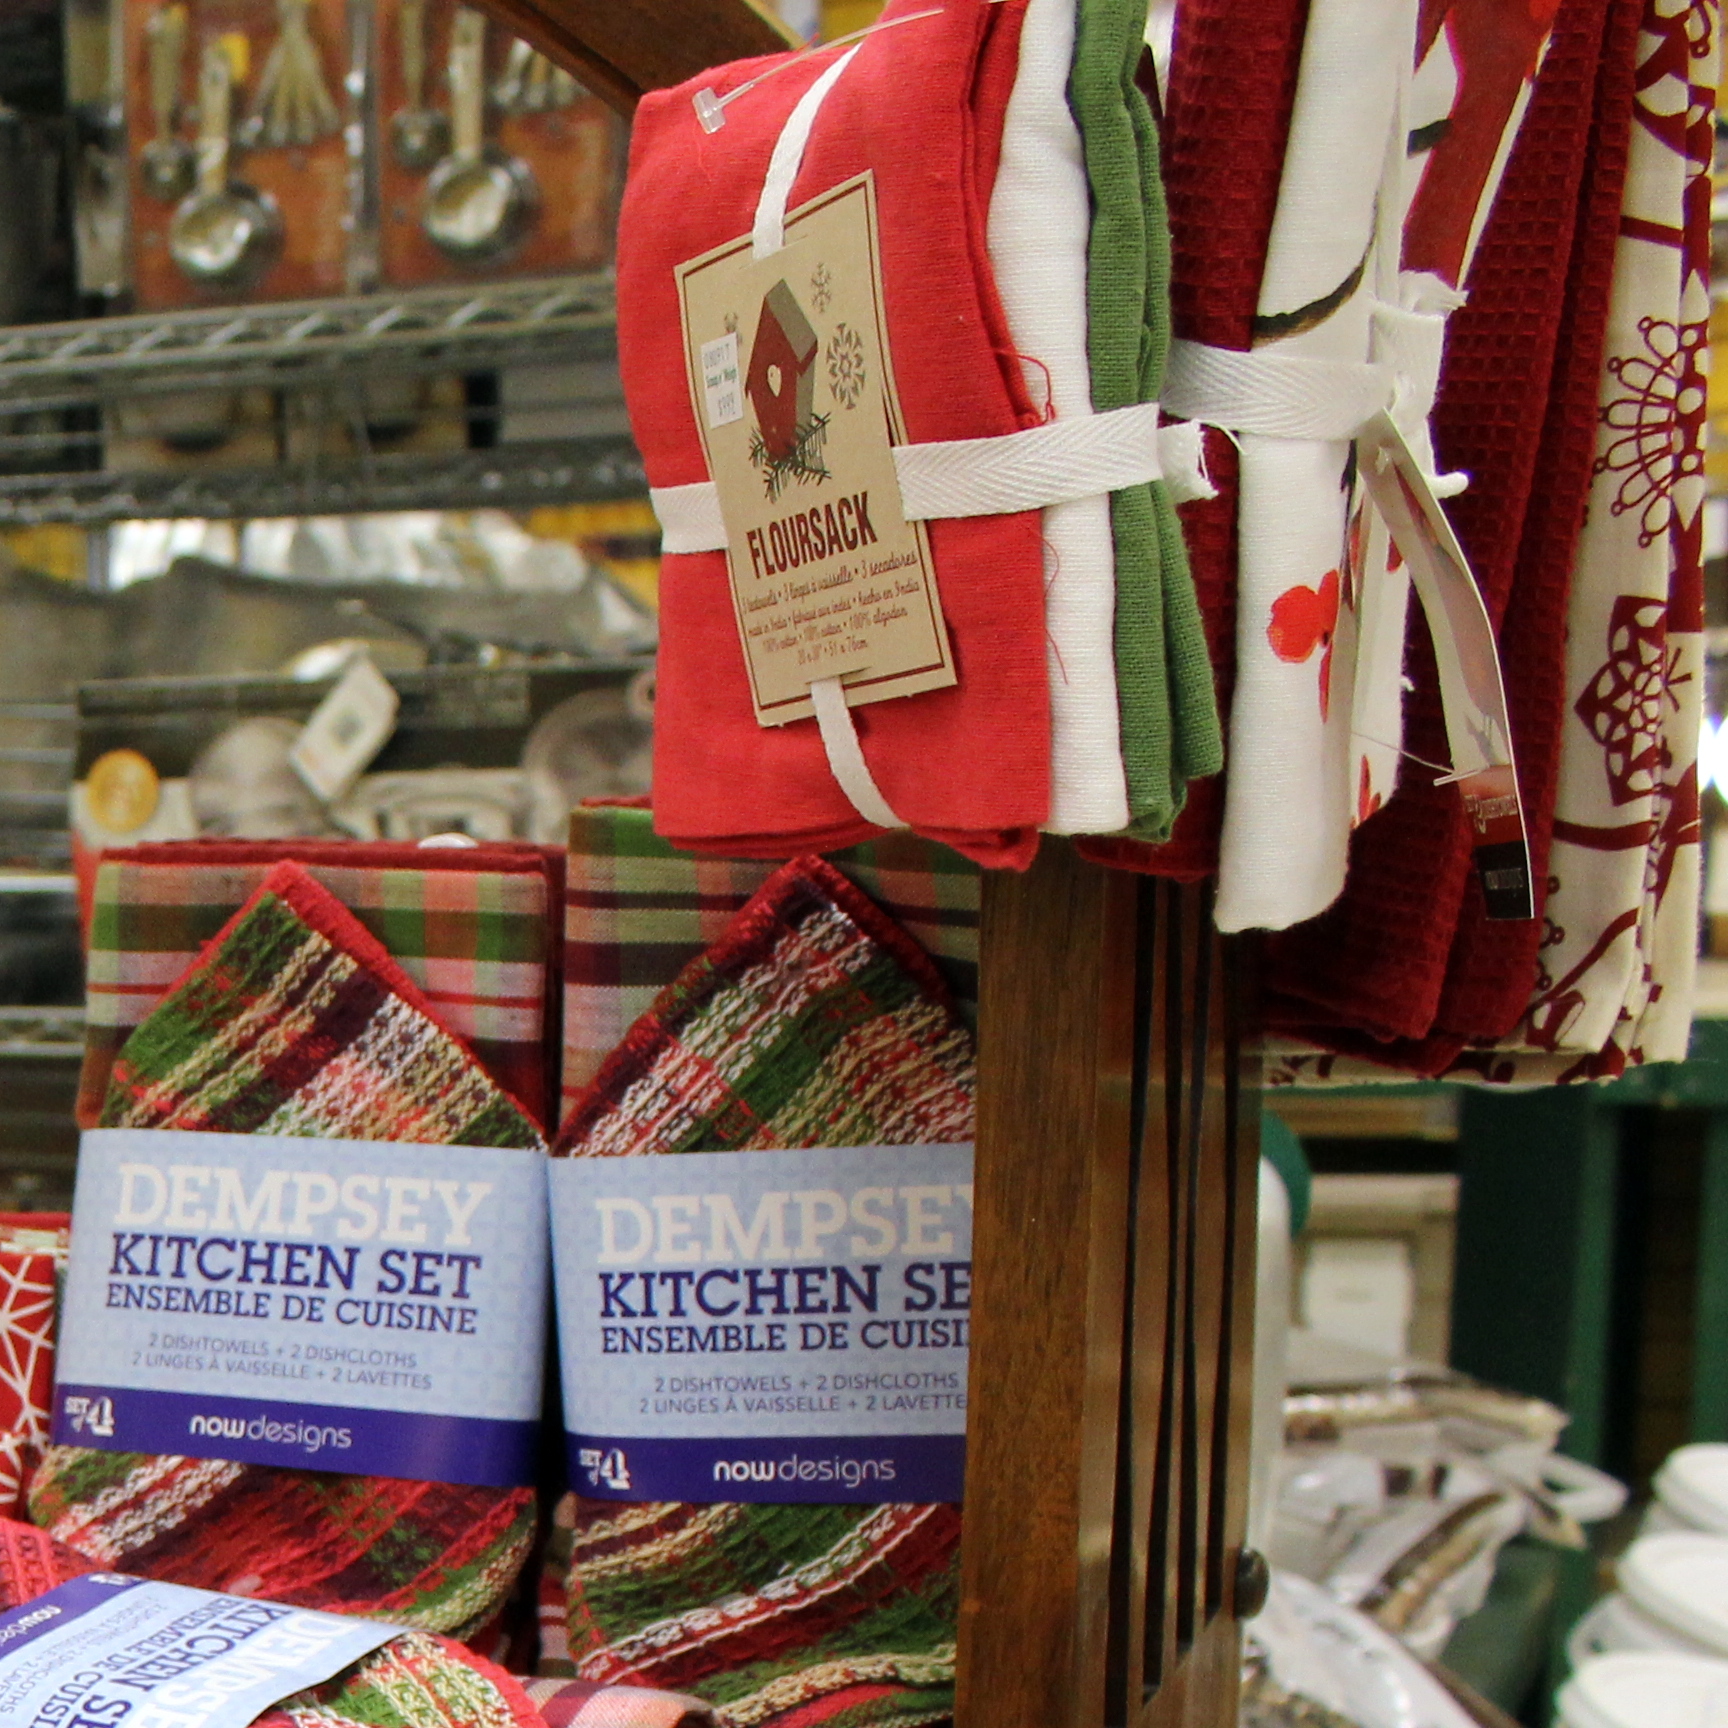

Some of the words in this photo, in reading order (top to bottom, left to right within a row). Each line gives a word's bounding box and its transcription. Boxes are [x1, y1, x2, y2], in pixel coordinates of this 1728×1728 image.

[746, 491, 878, 580] FLOURSACK
[113, 1163, 492, 1247] DEMPSEY
[595, 1184, 974, 1264] DEMPSE
[108, 1233, 361, 1291] KITCHEN
[377, 1249, 482, 1300] SET
[106, 1283, 271, 1320] ENSEMBLE
[281, 1296, 326, 1324] DE
[336, 1299, 479, 1336] CUISINE
[598, 1264, 882, 1319] KITCHEN
[904, 1261, 972, 1312] SE
[149, 1333, 160, 1349] 2
[162, 1335, 270, 1358] DISHTOWELS
[291, 1344, 302, 1360] 2
[304, 1345, 418, 1368] DISHCLOTHS
[601, 1322, 787, 1355] ENSEMBLE
[800, 1321, 850, 1352] DE
[861, 1317, 970, 1350] CUISI
[132, 1352, 142, 1367] 2
[145, 1353, 206, 1372] LINGES
[225, 1359, 311, 1381] VAISSELLE
[332, 1368, 343, 1384] 2
[347, 1369, 433, 1391] LAVETTES
[654, 1378, 665, 1393] 2
[671, 1376, 792, 1393] DISHTOWELS
[816, 1376, 827, 1391] 2
[833, 1373, 960, 1391] DISHCLOTHS
[85, 1396, 115, 1437] 4
[640, 1399, 650, 1414] 2
[654, 1397, 720, 1415] LINGES
[742, 1395, 841, 1414] VAISSELLE
[866, 1396, 878, 1411] 2
[882, 1393, 968, 1411] LAVETTE
[189, 1413, 353, 1453] nowdesigns
[601, 1448, 631, 1490] 4
[713, 1454, 896, 1489] nowdesigns
[123, 1597, 243, 1656] ENSEMBLE
[94, 1651, 137, 1673] DE
[110, 1603, 294, 1693] KITCHEN
